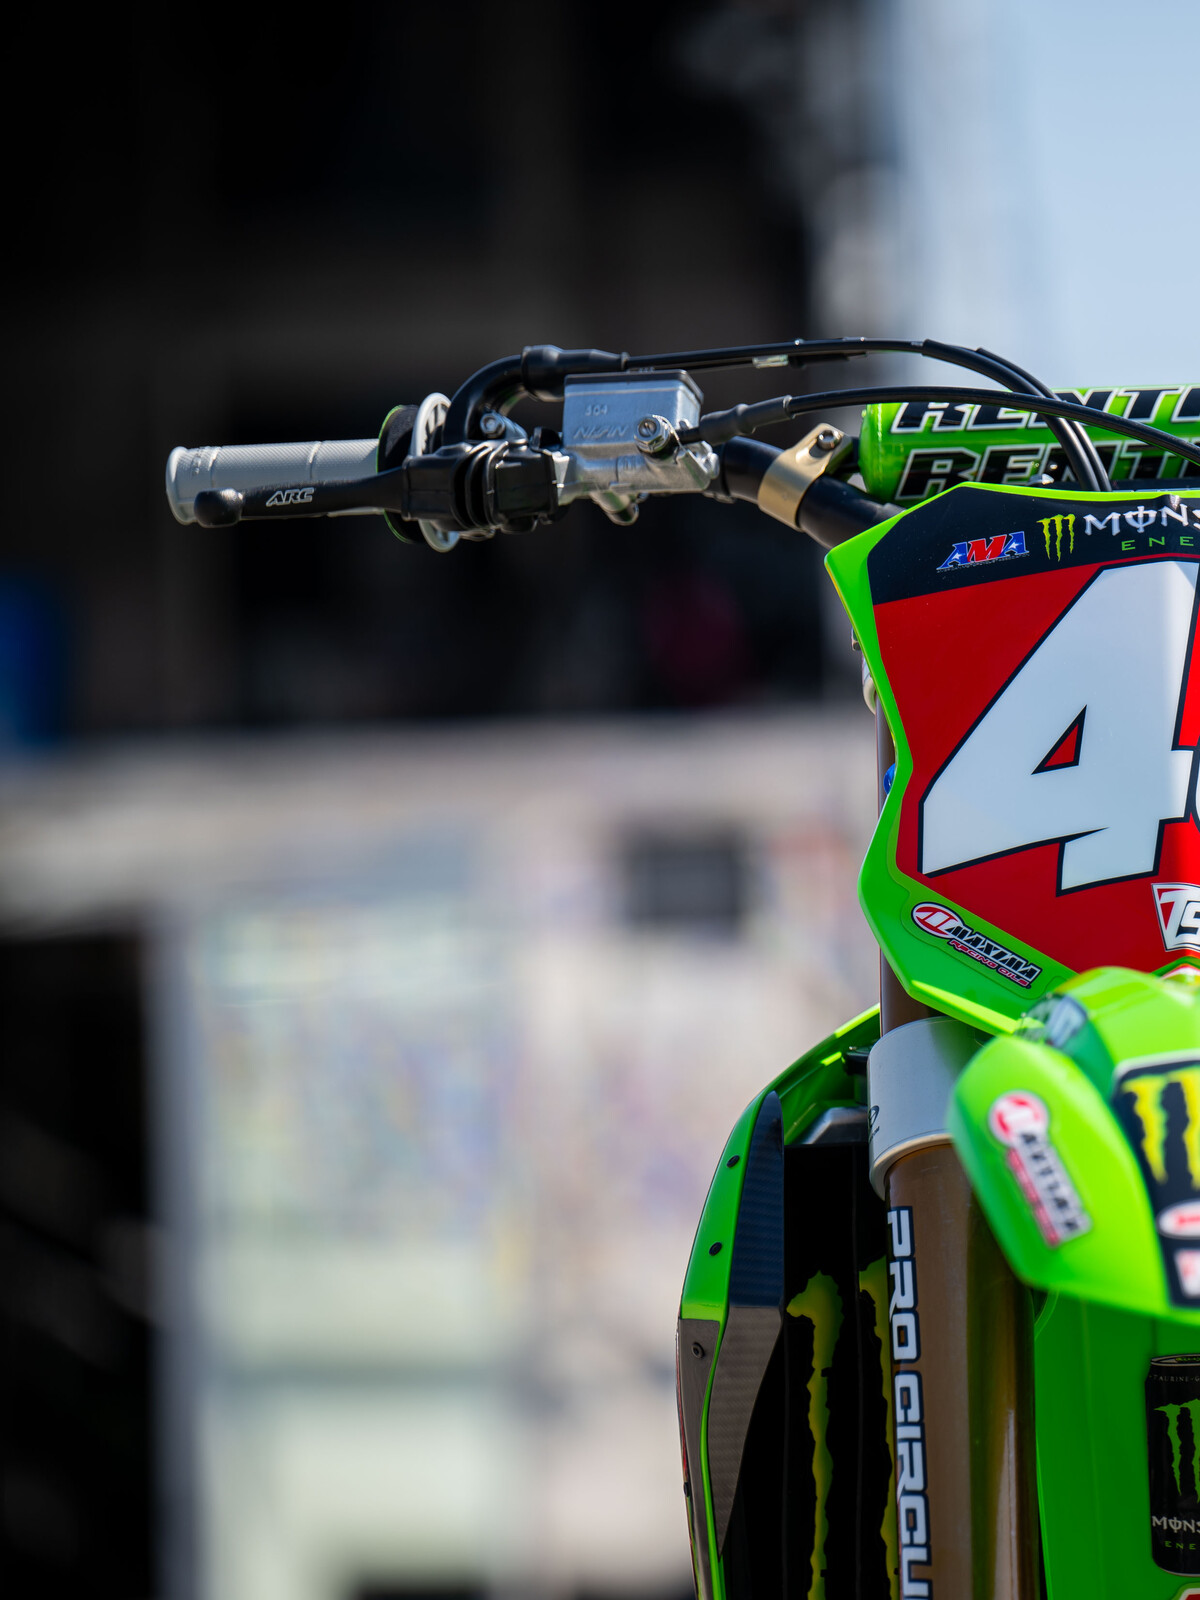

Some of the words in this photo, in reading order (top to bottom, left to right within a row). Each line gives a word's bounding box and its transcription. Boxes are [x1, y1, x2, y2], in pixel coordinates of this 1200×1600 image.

[266, 487, 315, 507] ARC
[936, 531, 1030, 570] AMA
[944, 925, 1041, 981] MAXIMA
[949, 939, 999, 969] RACING
[997, 967, 1031, 988] OILS
[887, 1209, 918, 1361] PRO
